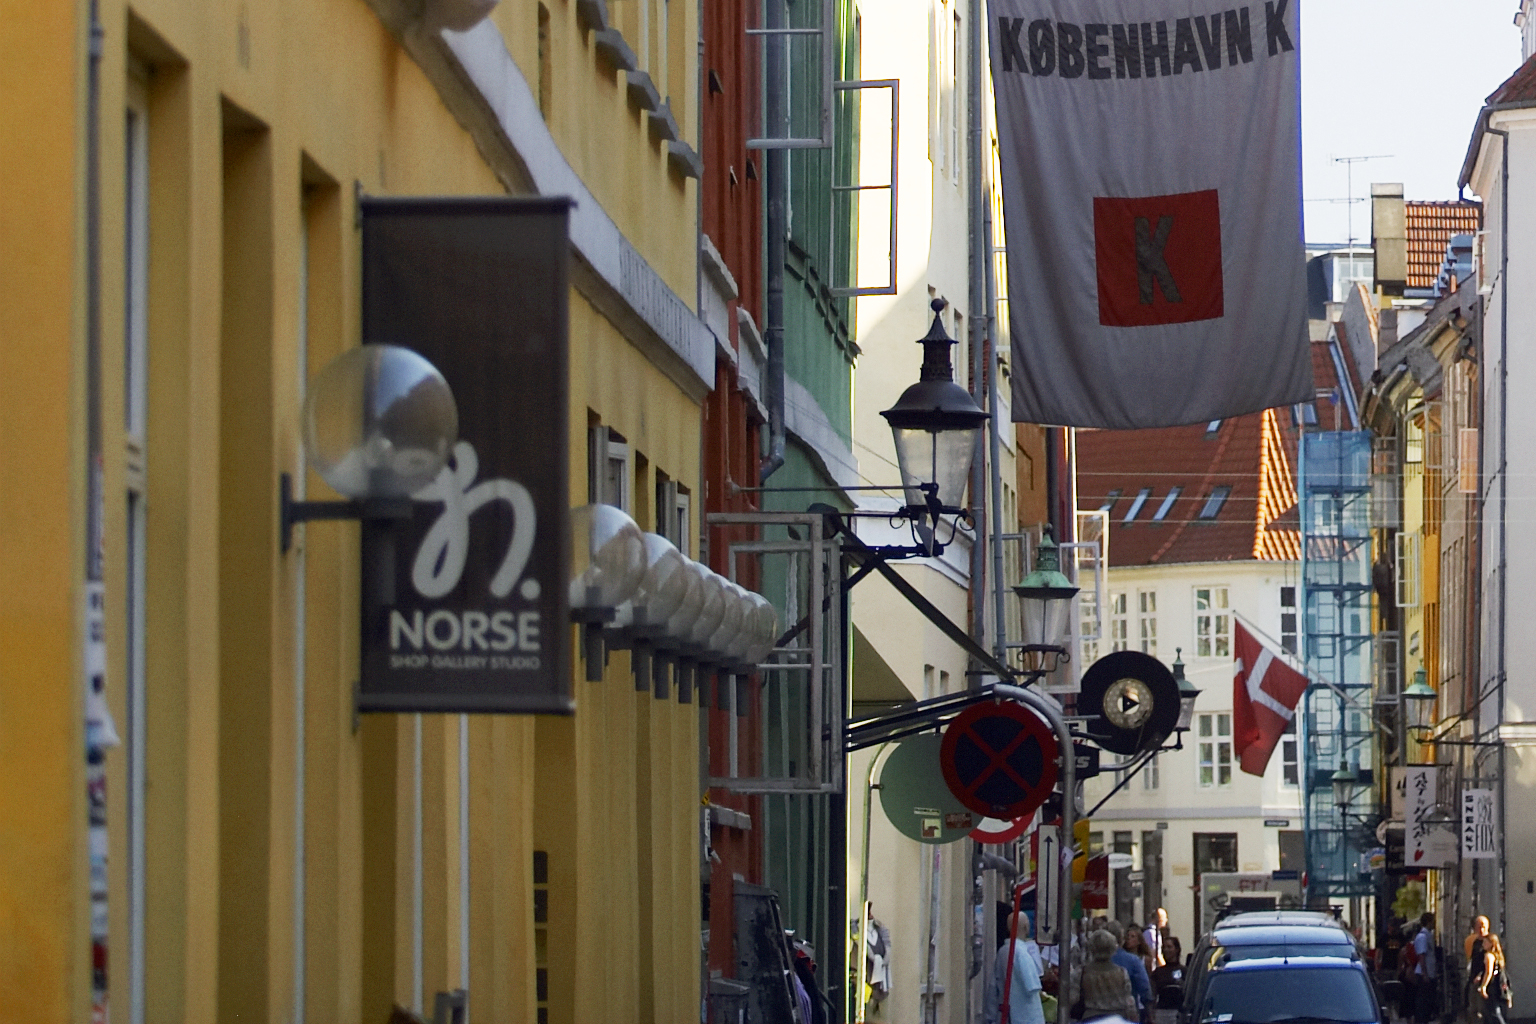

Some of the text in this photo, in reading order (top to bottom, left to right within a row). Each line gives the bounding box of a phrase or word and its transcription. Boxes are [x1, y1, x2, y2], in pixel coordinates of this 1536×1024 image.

[998, 6, 1254, 80] KØBENHAVN
[1133, 215, 1183, 305] K
[389, 609, 542, 652] NORSE
[389, 655, 542, 670] SHOP GALLERY STUDIO
[1465, 795, 1474, 852] SNEAKY
[1475, 823, 1495, 852] FOX
